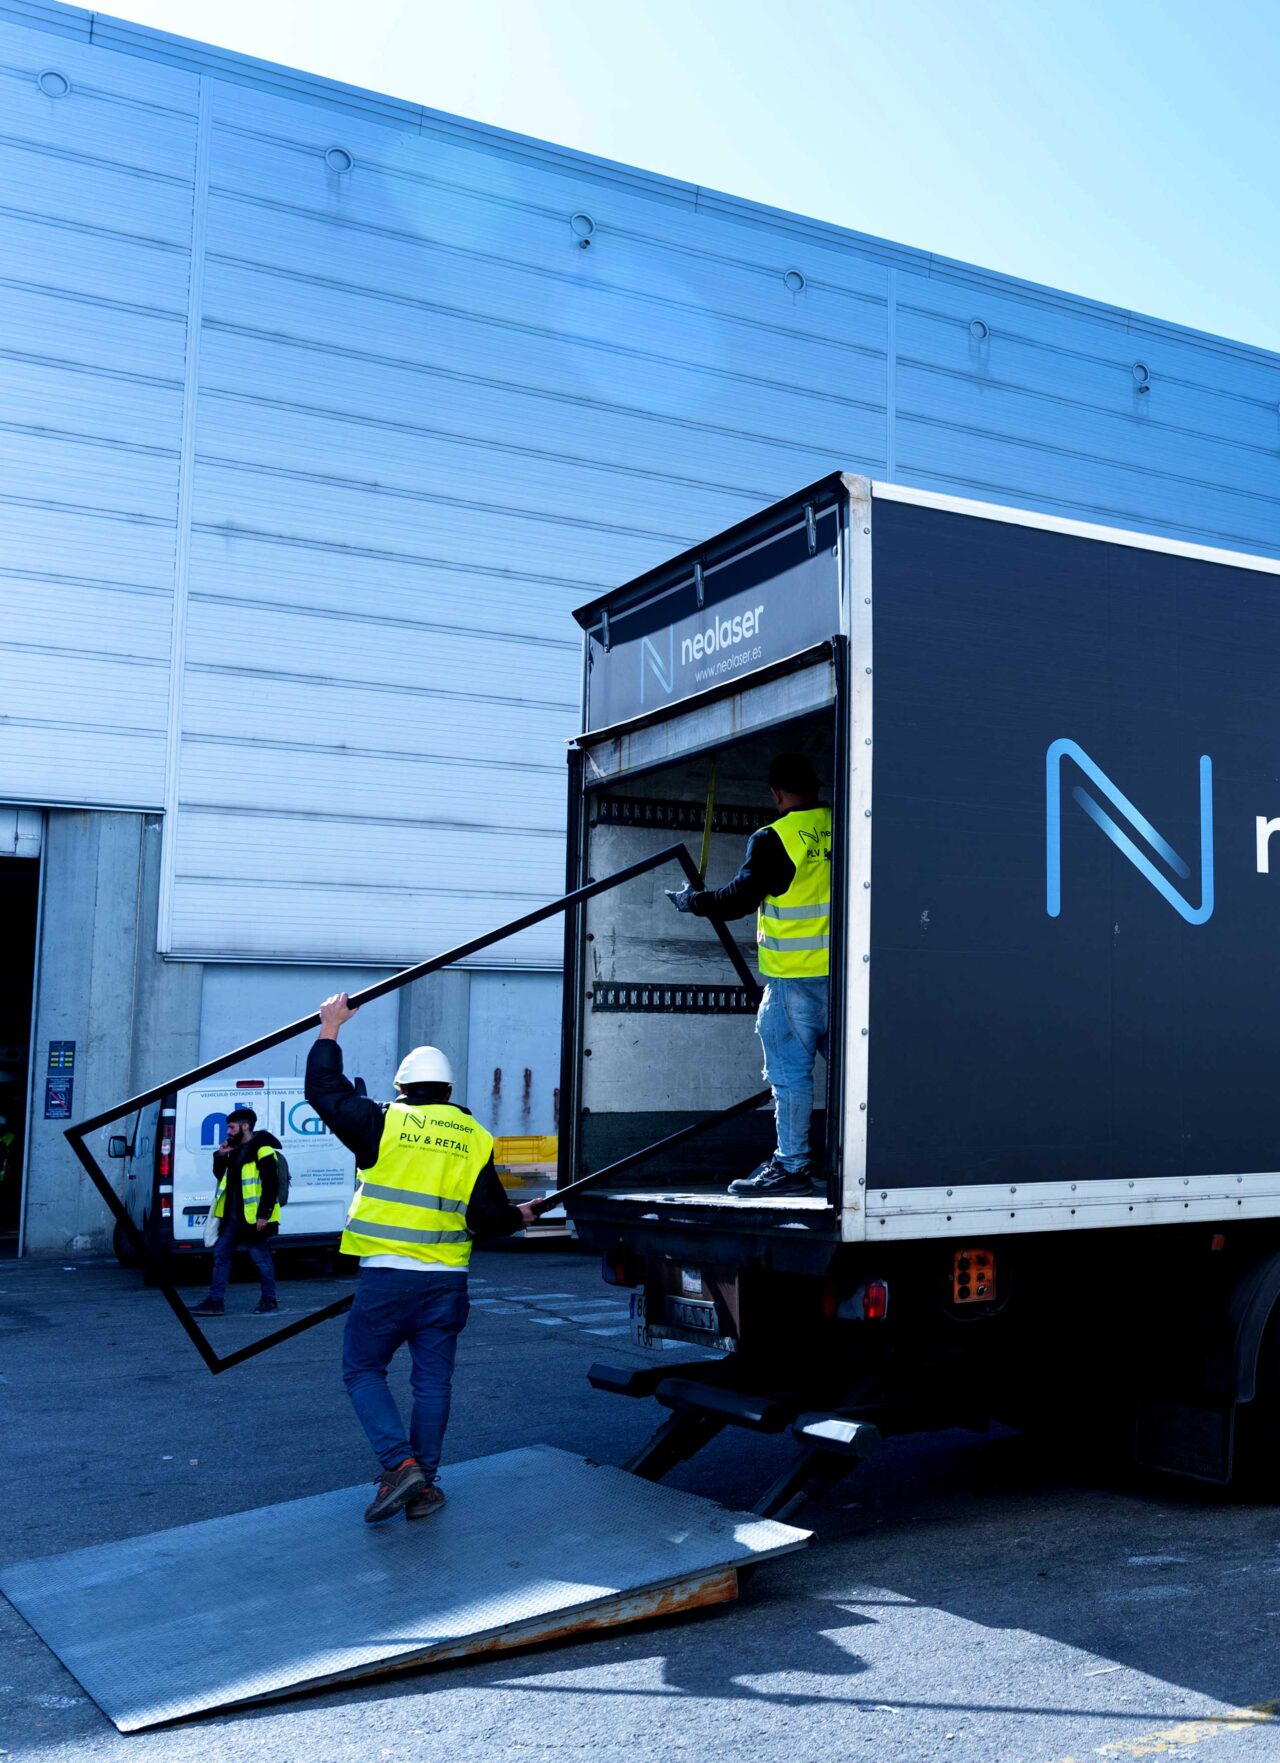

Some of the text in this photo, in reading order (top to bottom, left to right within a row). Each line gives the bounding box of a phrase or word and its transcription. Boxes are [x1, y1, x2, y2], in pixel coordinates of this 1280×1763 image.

[681, 605, 765, 666] neolaser
[695, 646, 762, 682] www.neolaser.es
[430, 1119, 475, 1134] neolaser
[400, 1132, 422, 1143] PLV
[424, 1136, 432, 1145] &
[435, 1137, 470, 1154] RETAIL
[195, 1215, 209, 1226] 47
